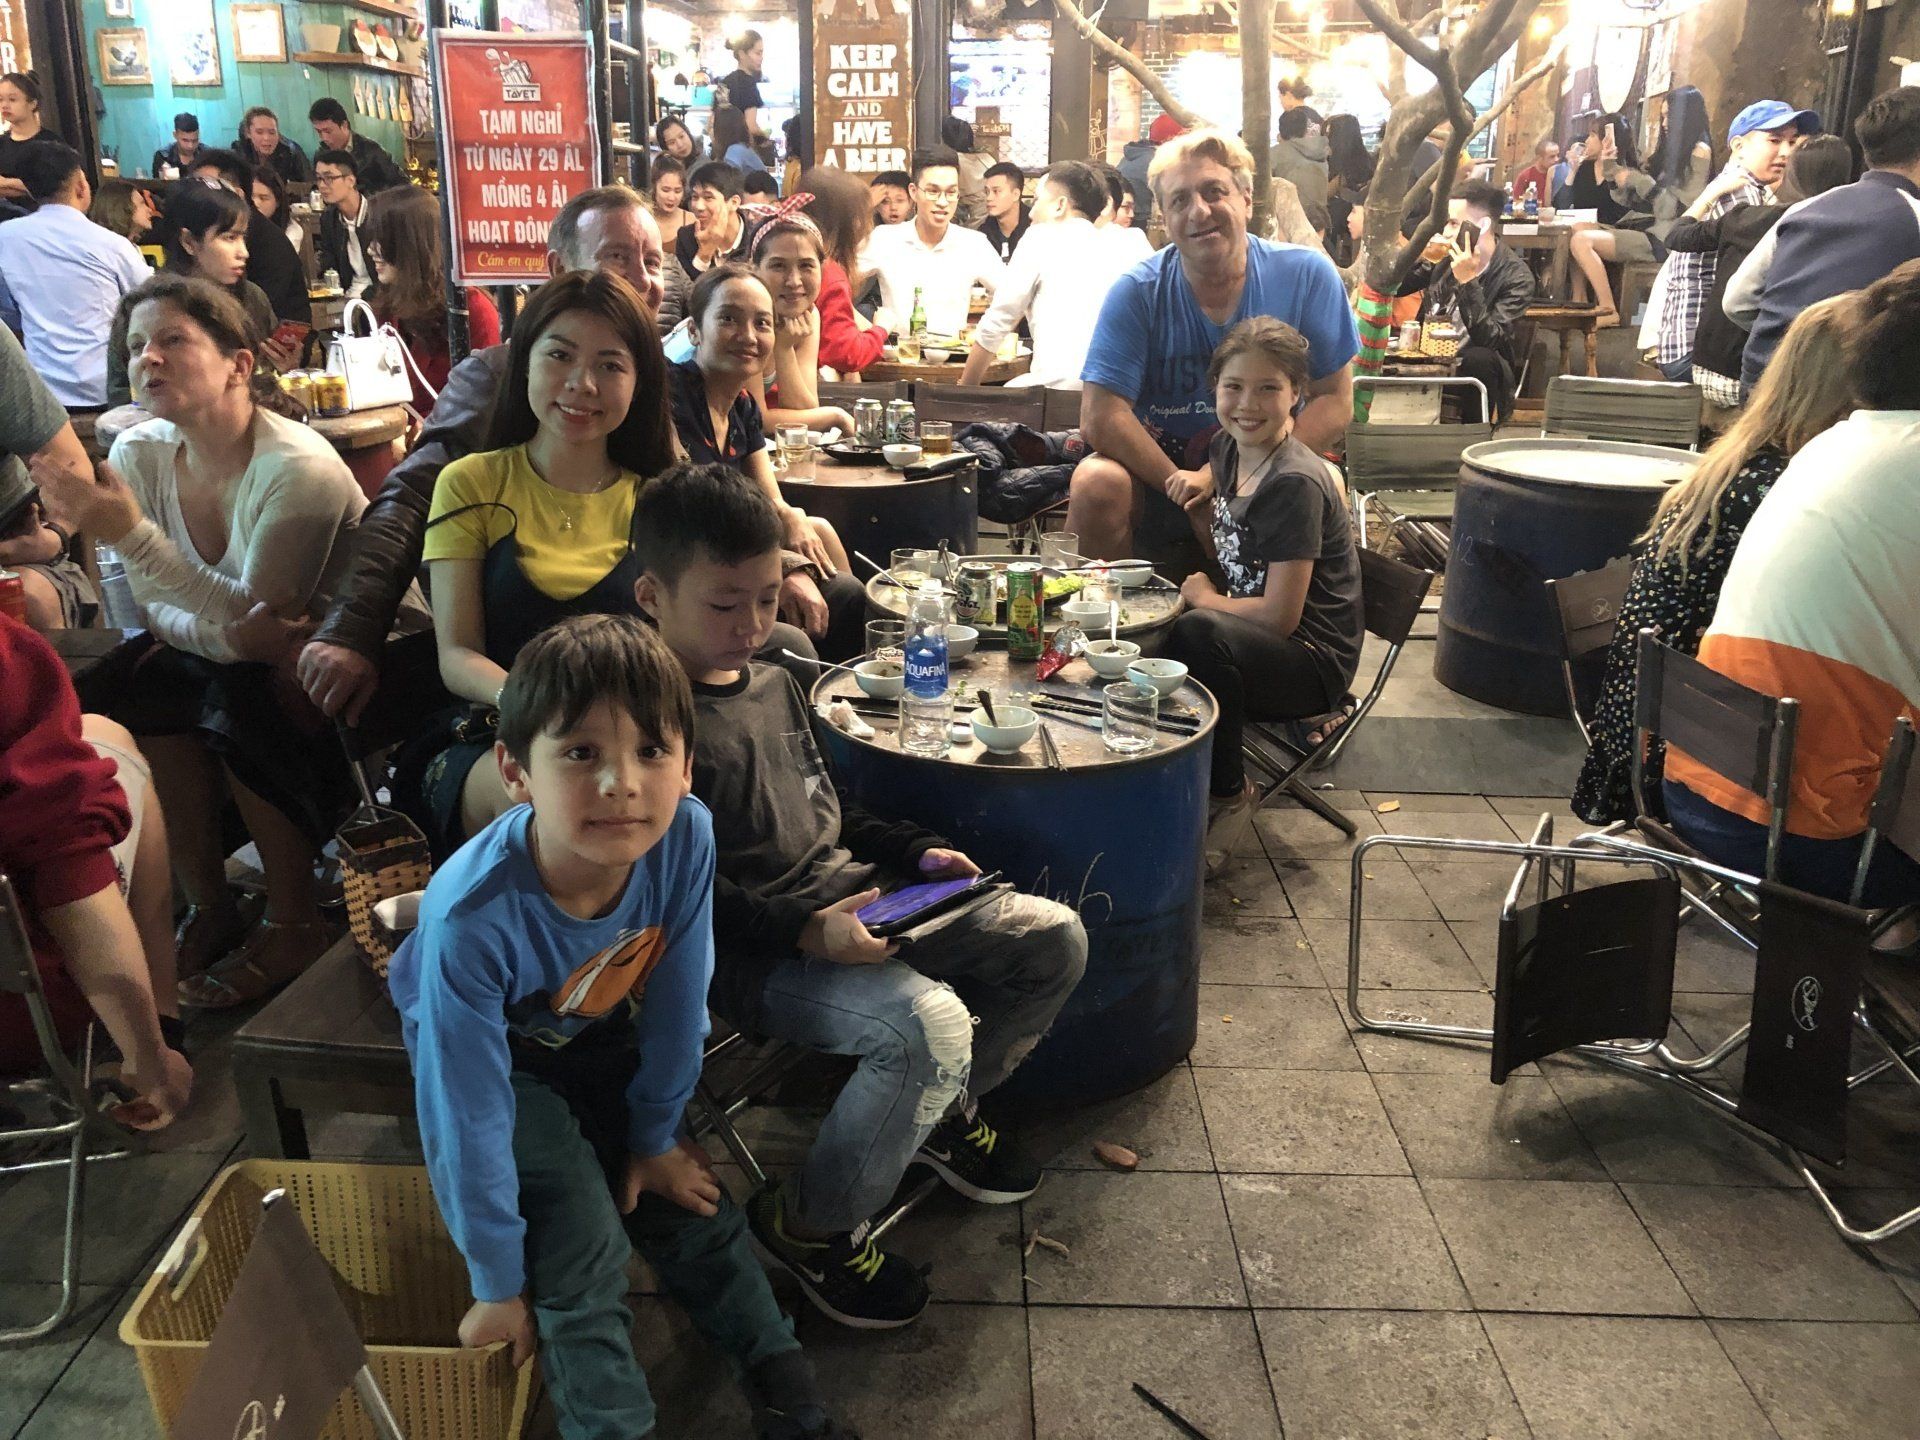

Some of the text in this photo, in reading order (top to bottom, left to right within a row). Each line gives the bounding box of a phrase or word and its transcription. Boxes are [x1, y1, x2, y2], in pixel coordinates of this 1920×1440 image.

[829, 44, 897, 69] KEEP
[827, 71, 899, 97] CALM
[479, 102, 563, 139] TẠM NGHỈ
[844, 102, 882, 116] AND
[832, 121, 893, 145] HAVE
[464, 142, 585, 171] TỪ NGÀY 29 ÂL
[823, 148, 907, 172] A BEER
[481, 175, 532, 208] MỒNG
[536, 184, 547, 208] 4
[467, 215, 552, 249] HOẠT ĐỘN
[1150, 403, 1192, 419] Original
[906, 660, 946, 678] AQUAFINA
